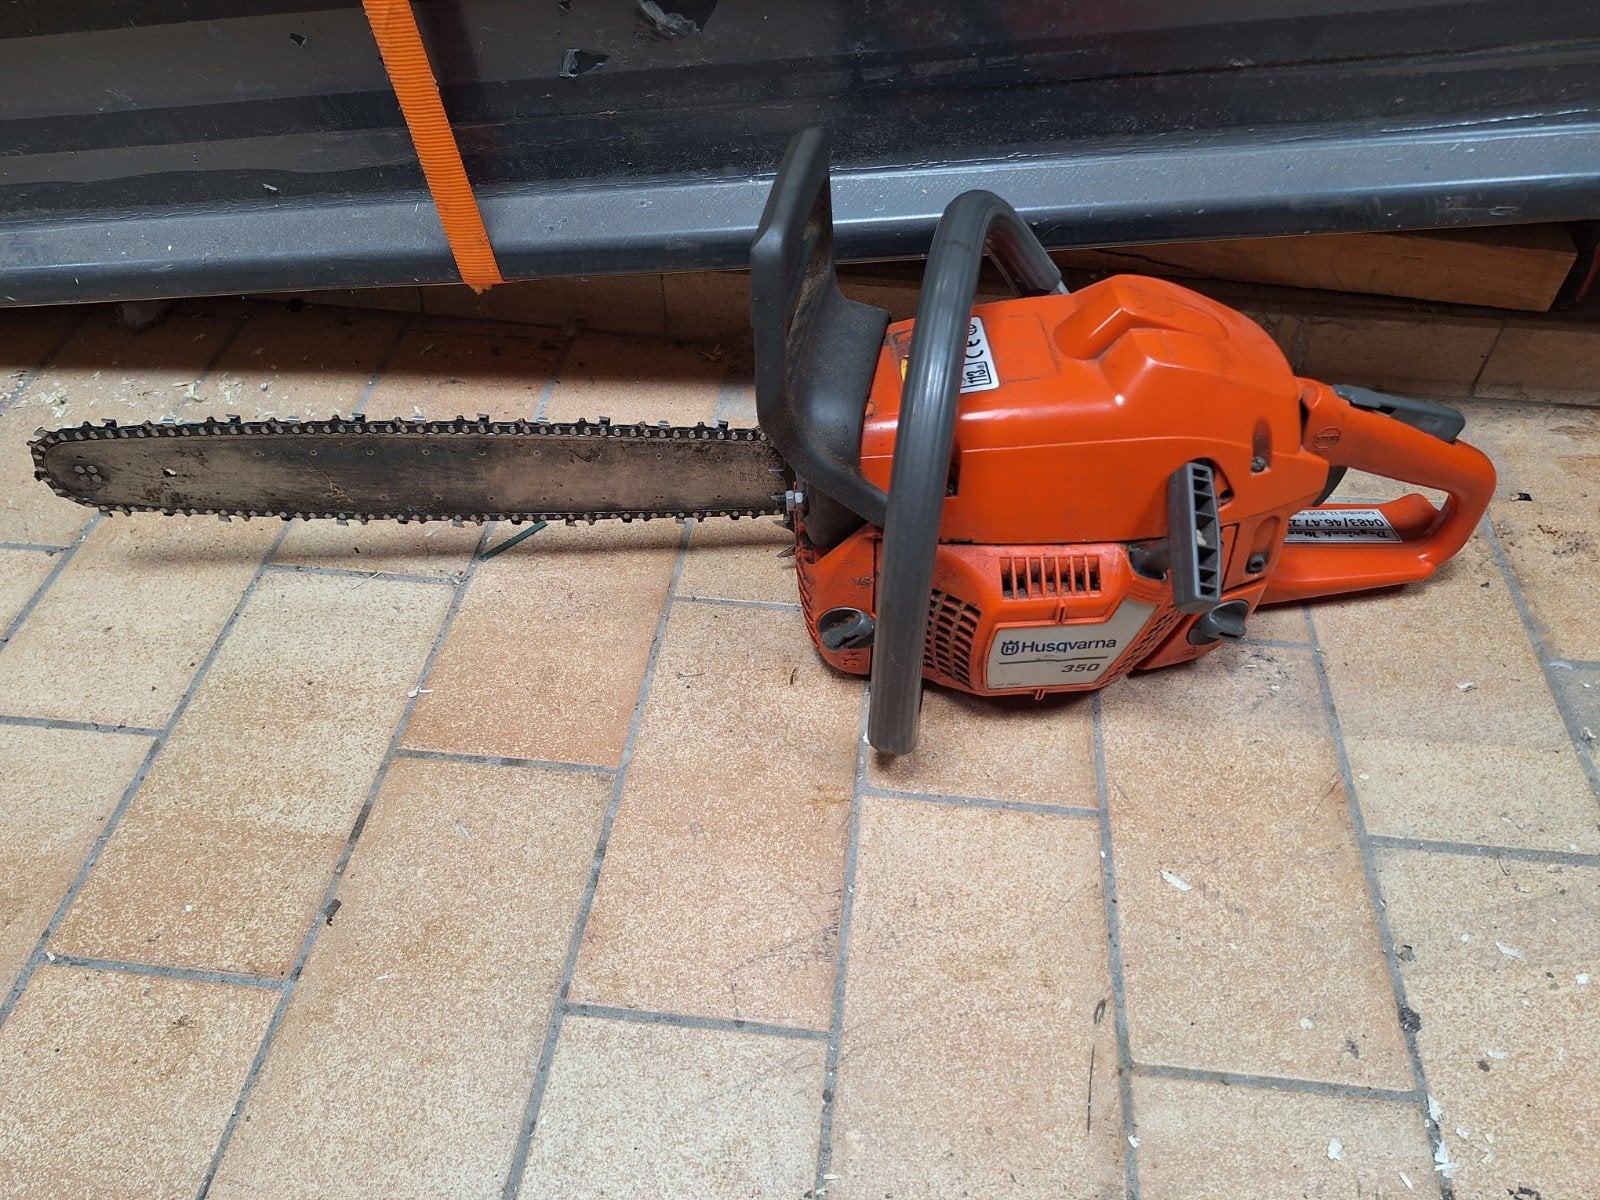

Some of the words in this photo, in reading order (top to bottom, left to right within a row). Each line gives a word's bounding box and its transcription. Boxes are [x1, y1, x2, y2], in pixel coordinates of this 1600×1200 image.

[1289, 518, 1384, 527] 0483/46.47.2
[1021, 639, 1117, 653] Husqvarna
[1061, 663, 1100, 673] 350
